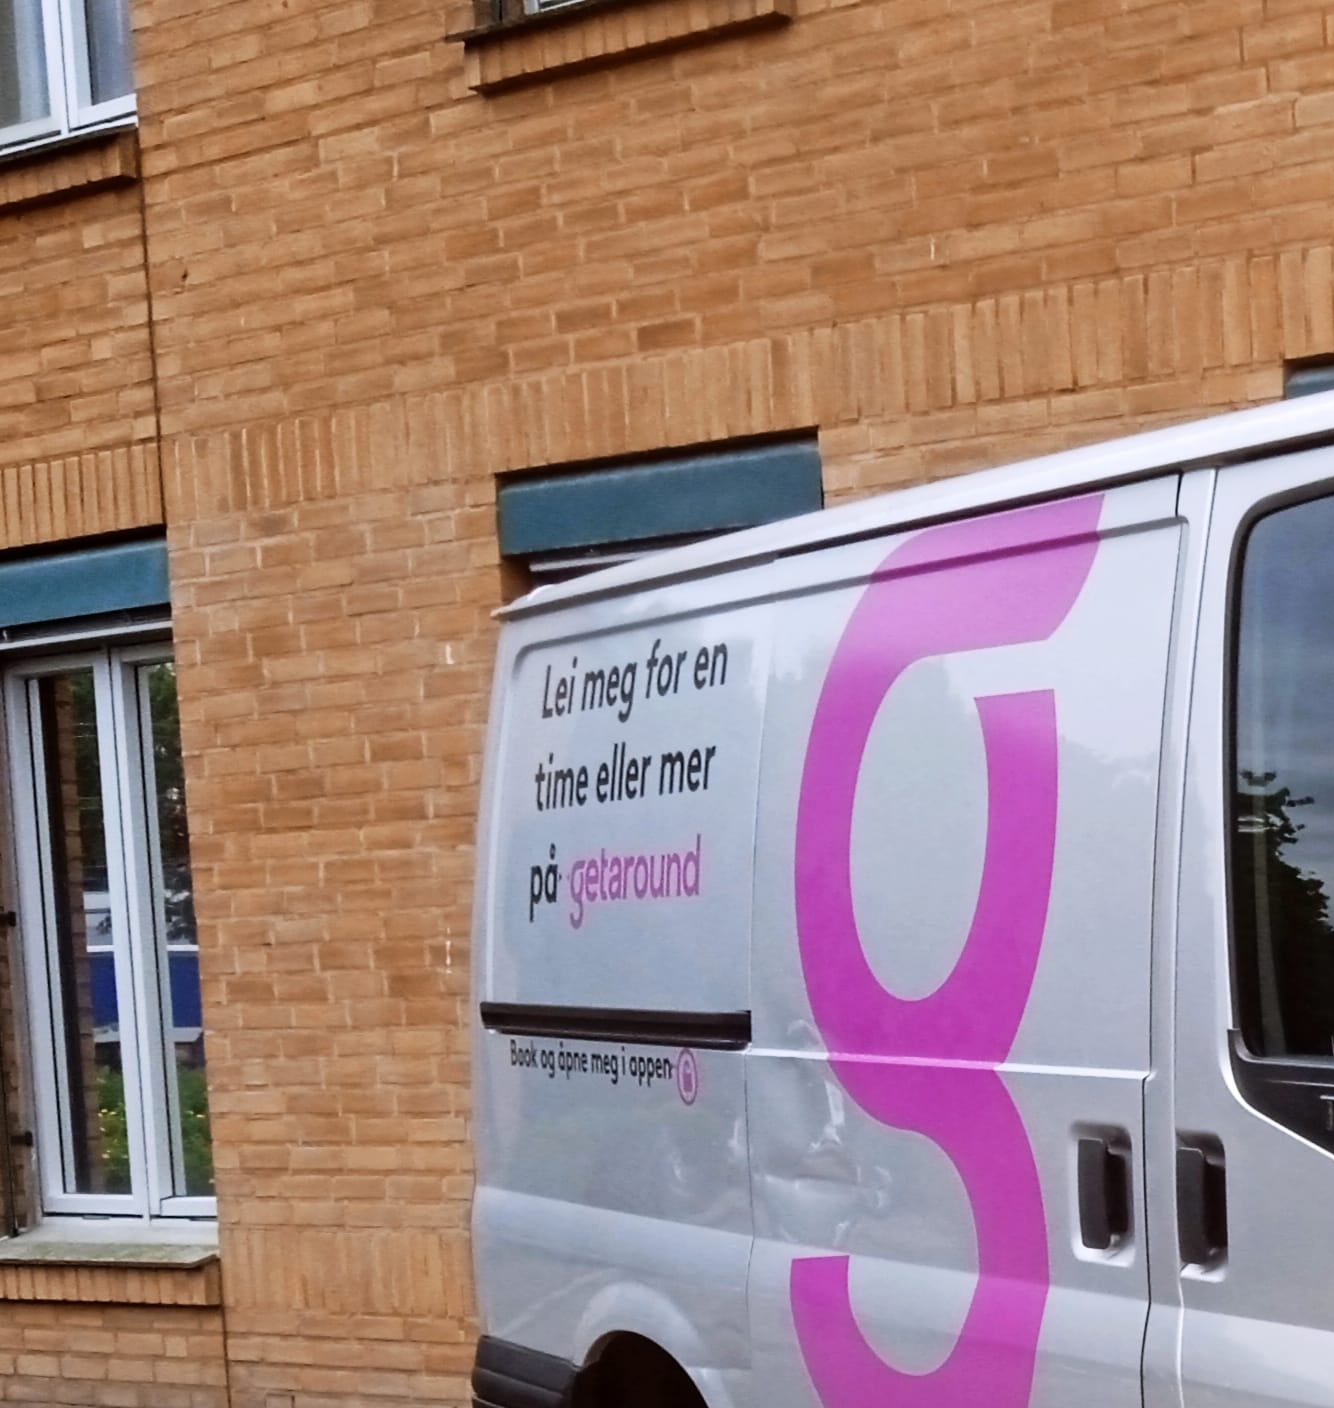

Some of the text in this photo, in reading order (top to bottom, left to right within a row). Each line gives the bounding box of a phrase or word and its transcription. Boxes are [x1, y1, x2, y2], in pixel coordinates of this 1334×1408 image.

[541, 638, 728, 723] Lei meg for en
[535, 741, 717, 812] time eller mer
[529, 833, 701, 930] på getaround
[510, 1038, 673, 1089] Book og åpne meg i appen
